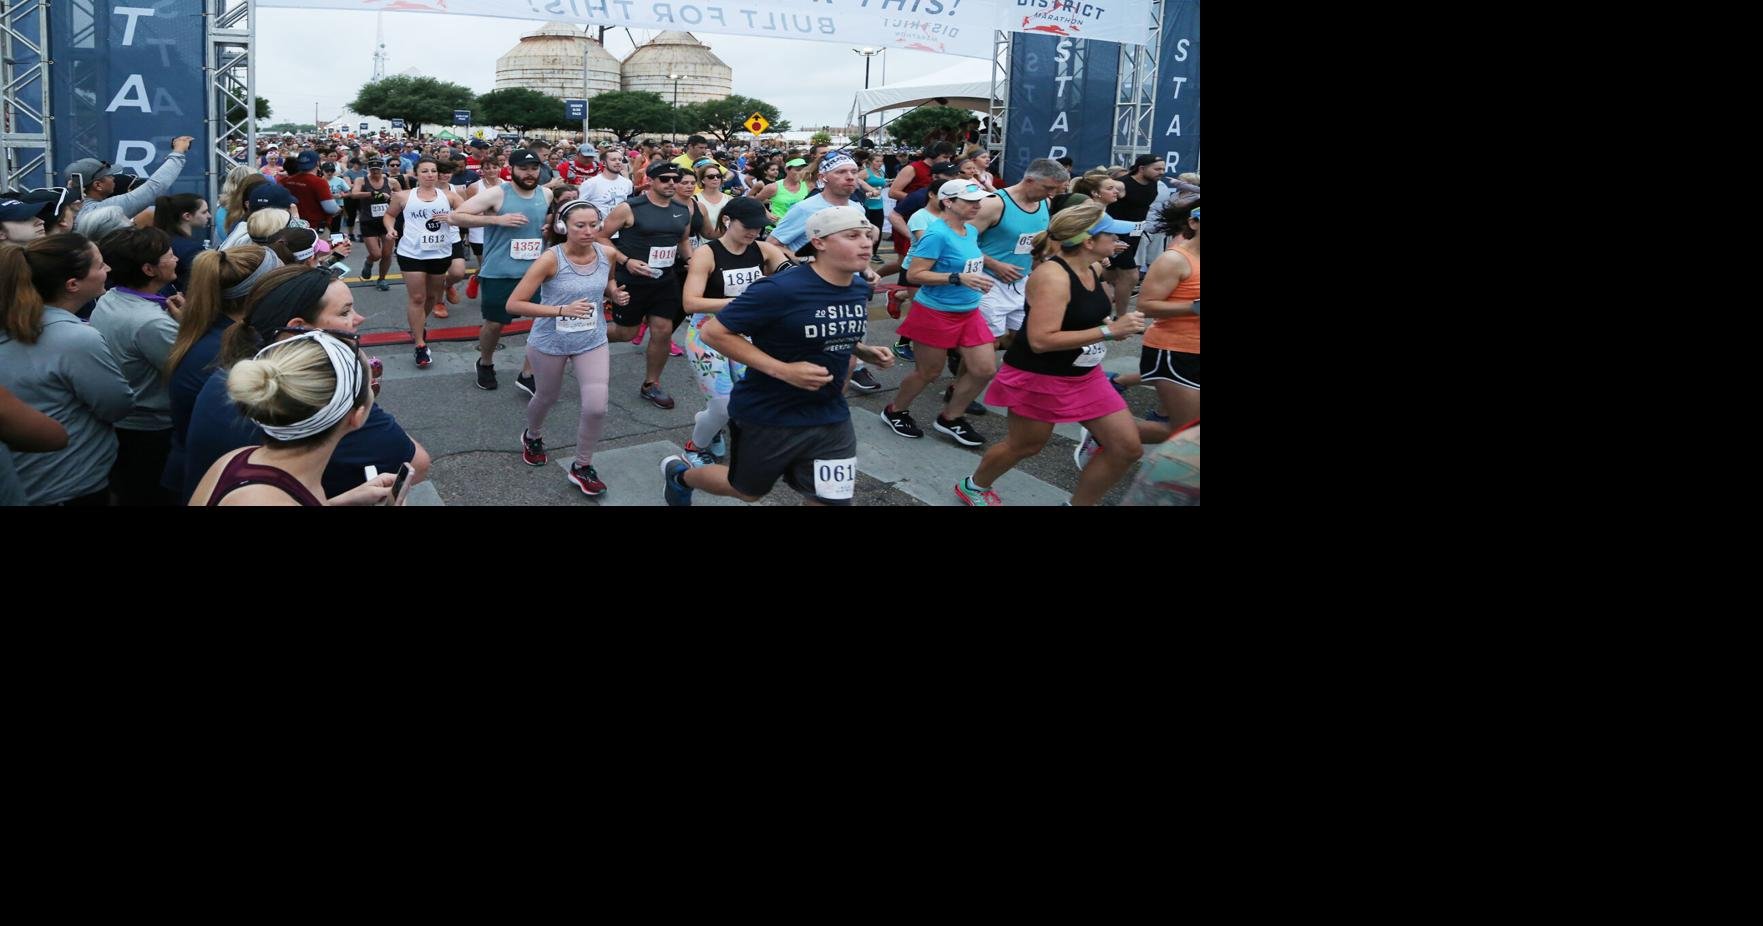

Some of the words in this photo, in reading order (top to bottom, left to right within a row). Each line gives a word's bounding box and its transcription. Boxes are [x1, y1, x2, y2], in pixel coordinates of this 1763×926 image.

[860, 0, 963, 17] HIS!
[1033, 12, 1084, 25] MARATHON
[1165, 38, 1190, 192] STAR
[421, 234, 445, 244] 1612
[513, 241, 541, 251] 4357
[815, 309, 826, 318] 20
[820, 464, 854, 482] 061
